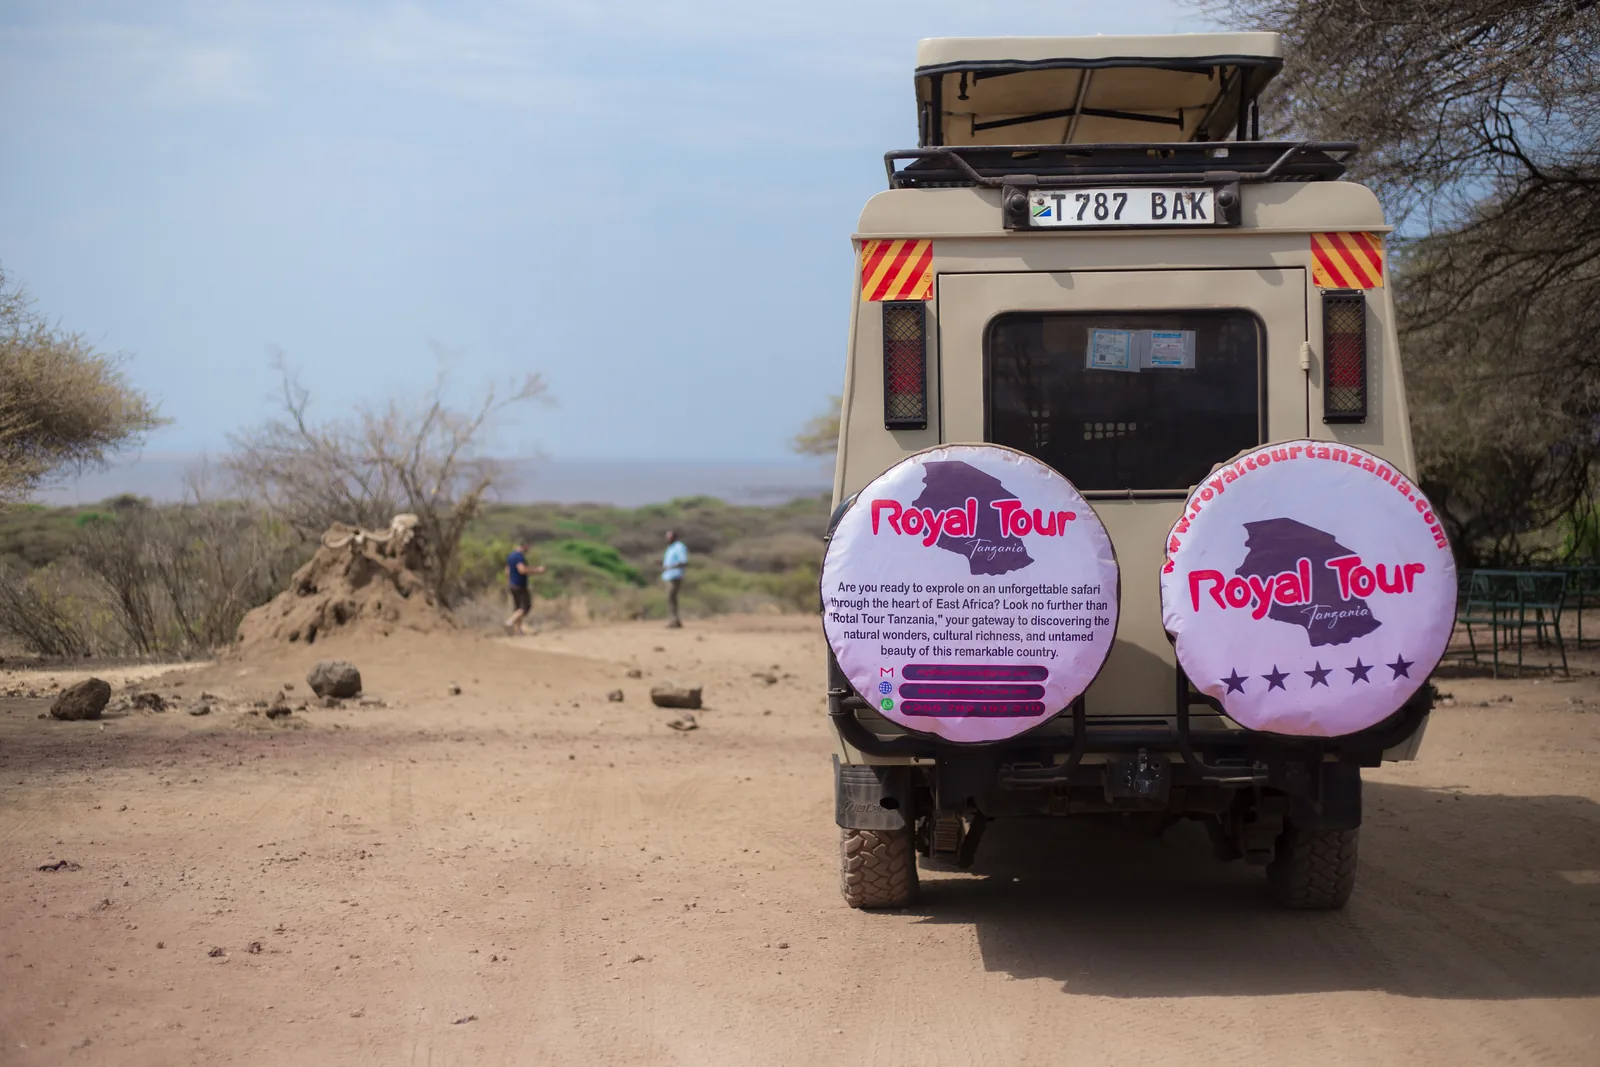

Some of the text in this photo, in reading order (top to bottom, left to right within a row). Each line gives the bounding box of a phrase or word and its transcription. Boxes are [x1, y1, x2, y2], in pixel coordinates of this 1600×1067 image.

[1050, 191, 1207, 221] T 787 BAK
[1163, 444, 1448, 574] www.royaltourtanzania.com
[870, 497, 1077, 547] Royal Tour
[964, 538, 1024, 561] Tanzania
[838, 581, 1101, 596] Are you ready to exprole on an unforgettable safari
[1187, 555, 1426, 620] Royal Tour
[831, 597, 1108, 610] through the heart of East Africa? Look no further than
[829, 612, 1110, 628] "Rotal Tour Tanzania," your gateway to discovering the
[1300, 604, 1370, 629] Tanzania
[843, 629, 1094, 642] natural wonders, cultural richness, and untamed
[880, 645, 1059, 659] beauty of this remarkable country.
